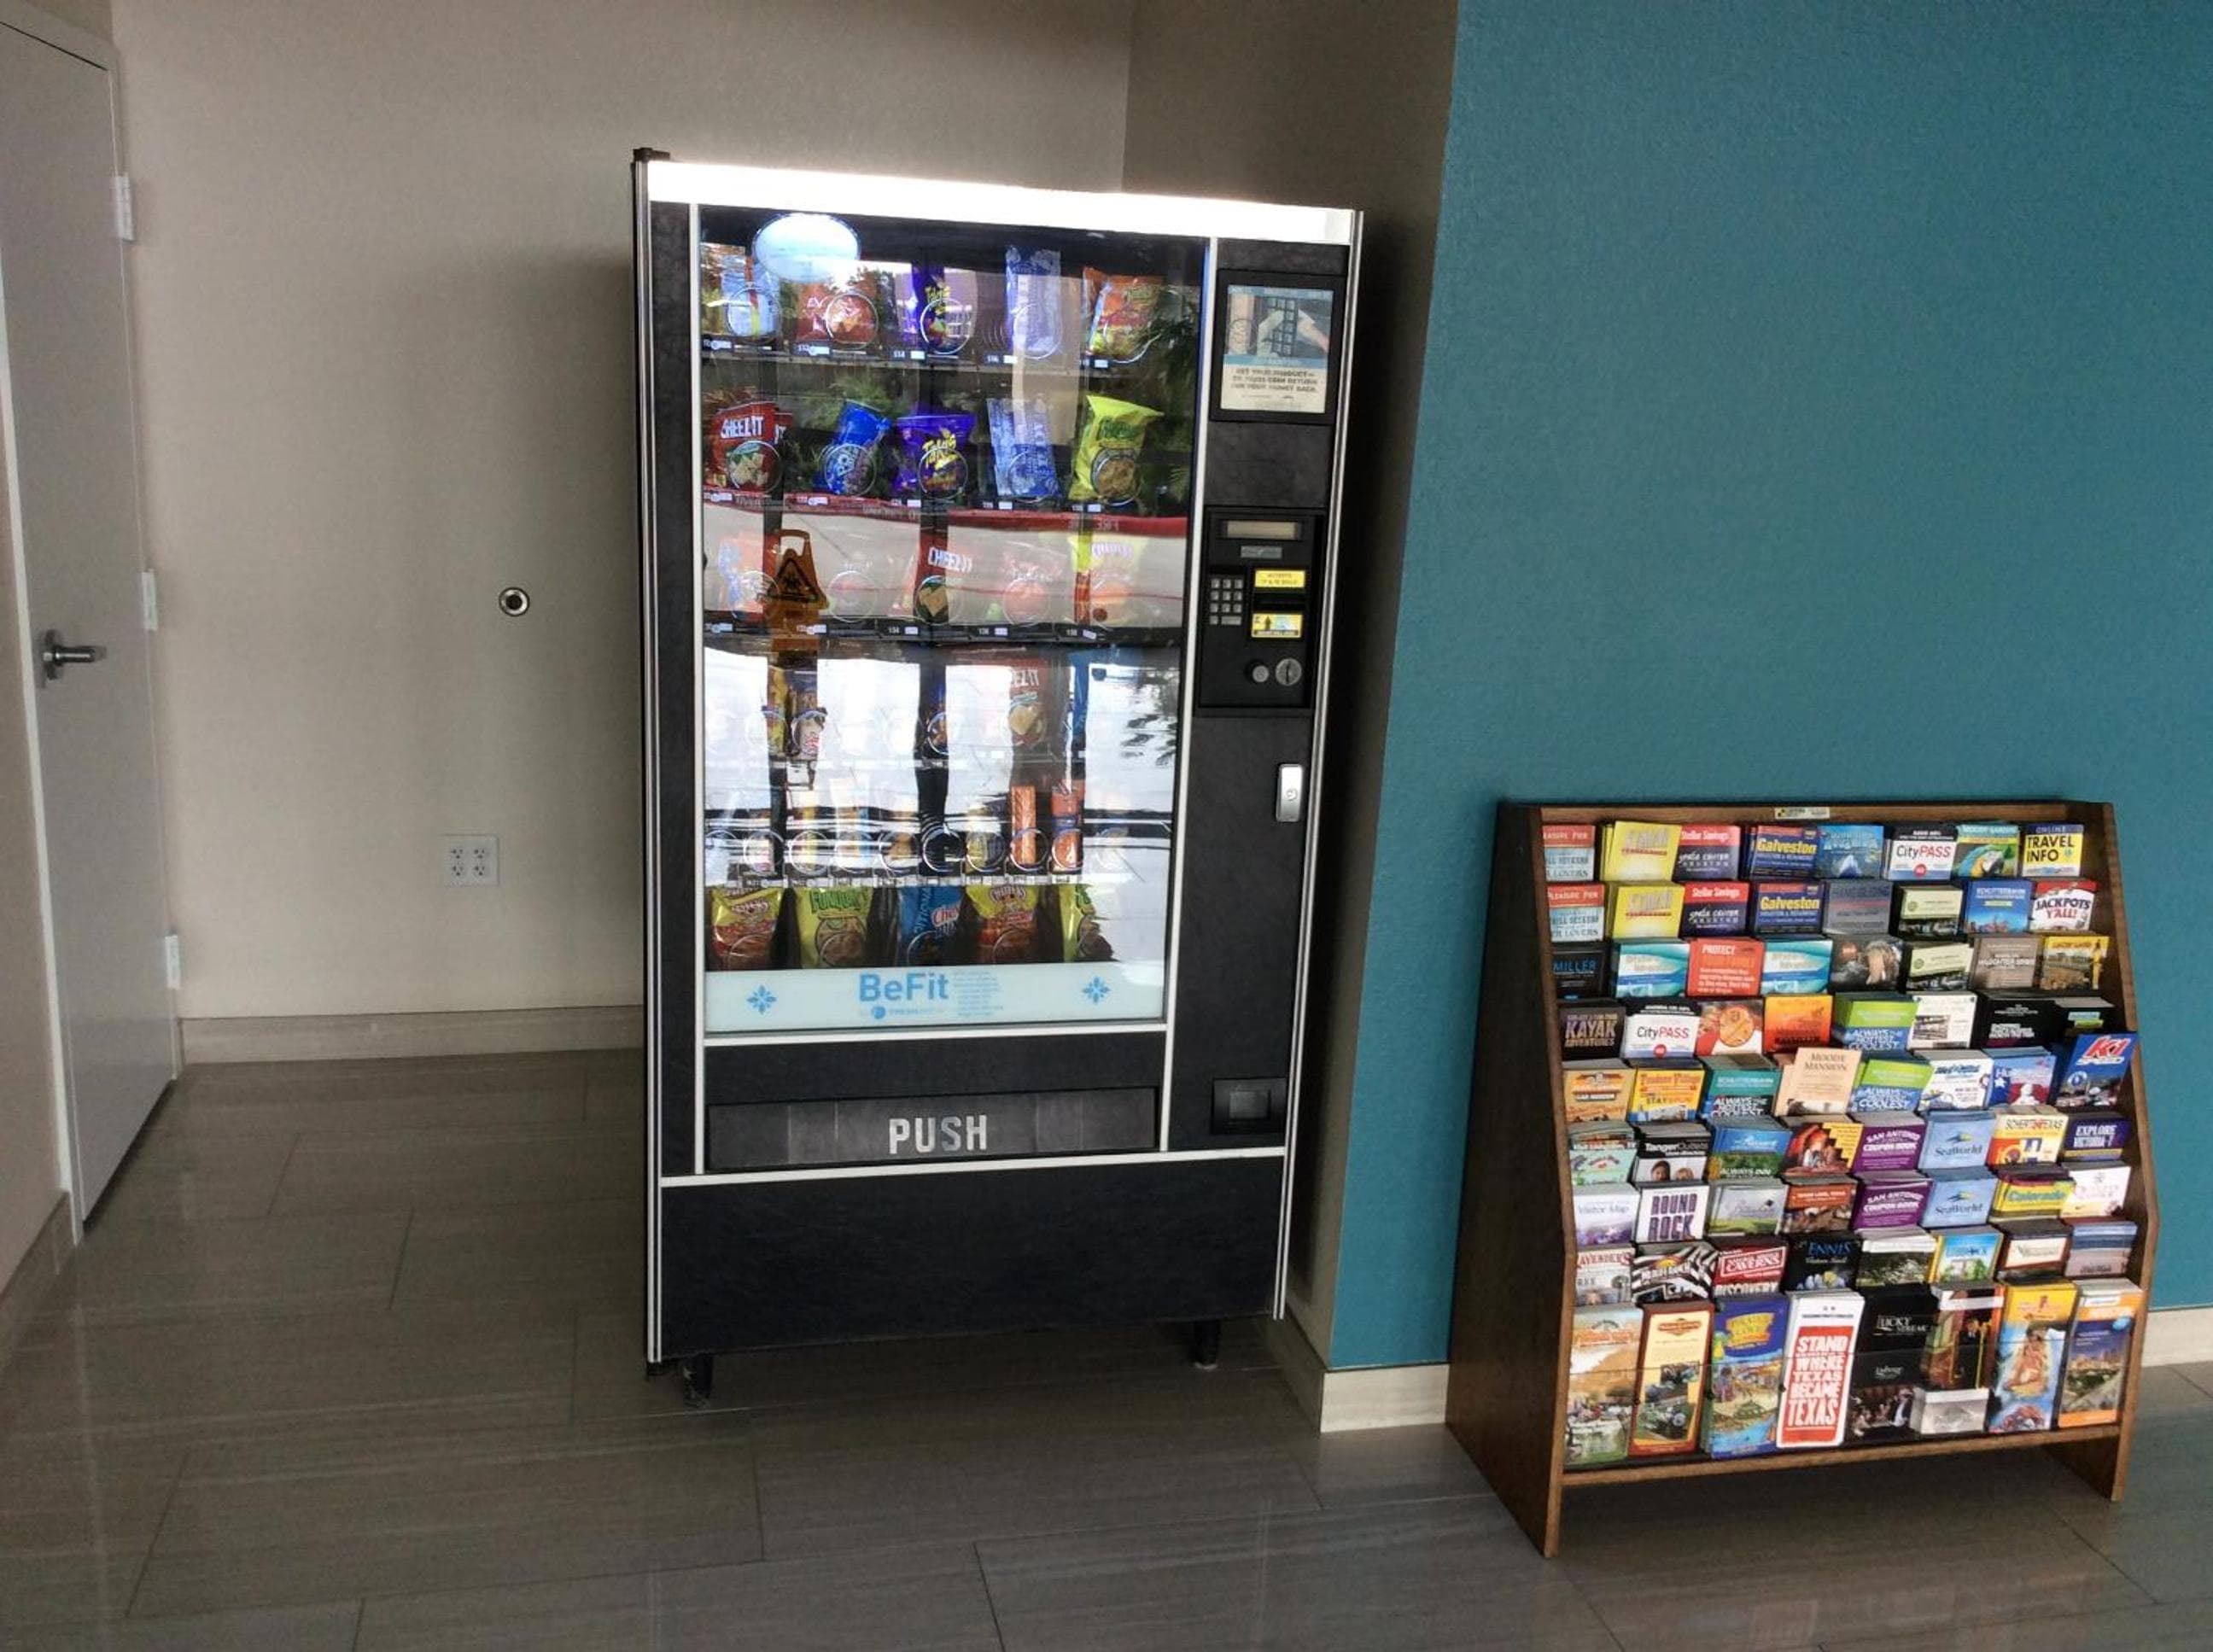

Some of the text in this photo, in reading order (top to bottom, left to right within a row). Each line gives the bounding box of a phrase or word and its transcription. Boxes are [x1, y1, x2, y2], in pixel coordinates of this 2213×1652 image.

[1756, 838, 1818, 855] Galveston
[2027, 835, 2075, 848] TRAVEL
[1896, 844, 1952, 859] CityPASS
[2026, 849, 2059, 862] INFO
[1760, 896, 1821, 911] Galveston
[2035, 897, 2092, 911] JACKPOTS
[1553, 960, 1597, 972] MILLER
[859, 972, 949, 1002] BeFit
[1564, 1019, 1618, 1039] KAYAK
[1636, 1025, 1690, 1039] CityPASS
[1564, 1037, 1615, 1048] ADVENTURES
[2085, 1034, 2131, 1057] K1
[888, 1114, 988, 1154] PUSH
[2075, 1124, 2117, 1136] EXPLORE
[1935, 1144, 1982, 1157] SeaWorld
[1650, 1193, 1698, 1215] ROUND
[1867, 1194, 1886, 1204] SAN
[1863, 1204, 1896, 1213] COUPON
[1935, 1203, 1982, 1215] SeaWorld
[1647, 1216, 1694, 1242] ROCK
[1725, 1256, 1781, 1272] CAVERNS
[1796, 1335, 1849, 1353] STAND
[1795, 1357, 1845, 1371] WHERE
[1793, 1371, 1843, 1382] TEXAS
[1790, 1382, 1842, 1398] BECAME
[1788, 1398, 1838, 1427] TEXAS
